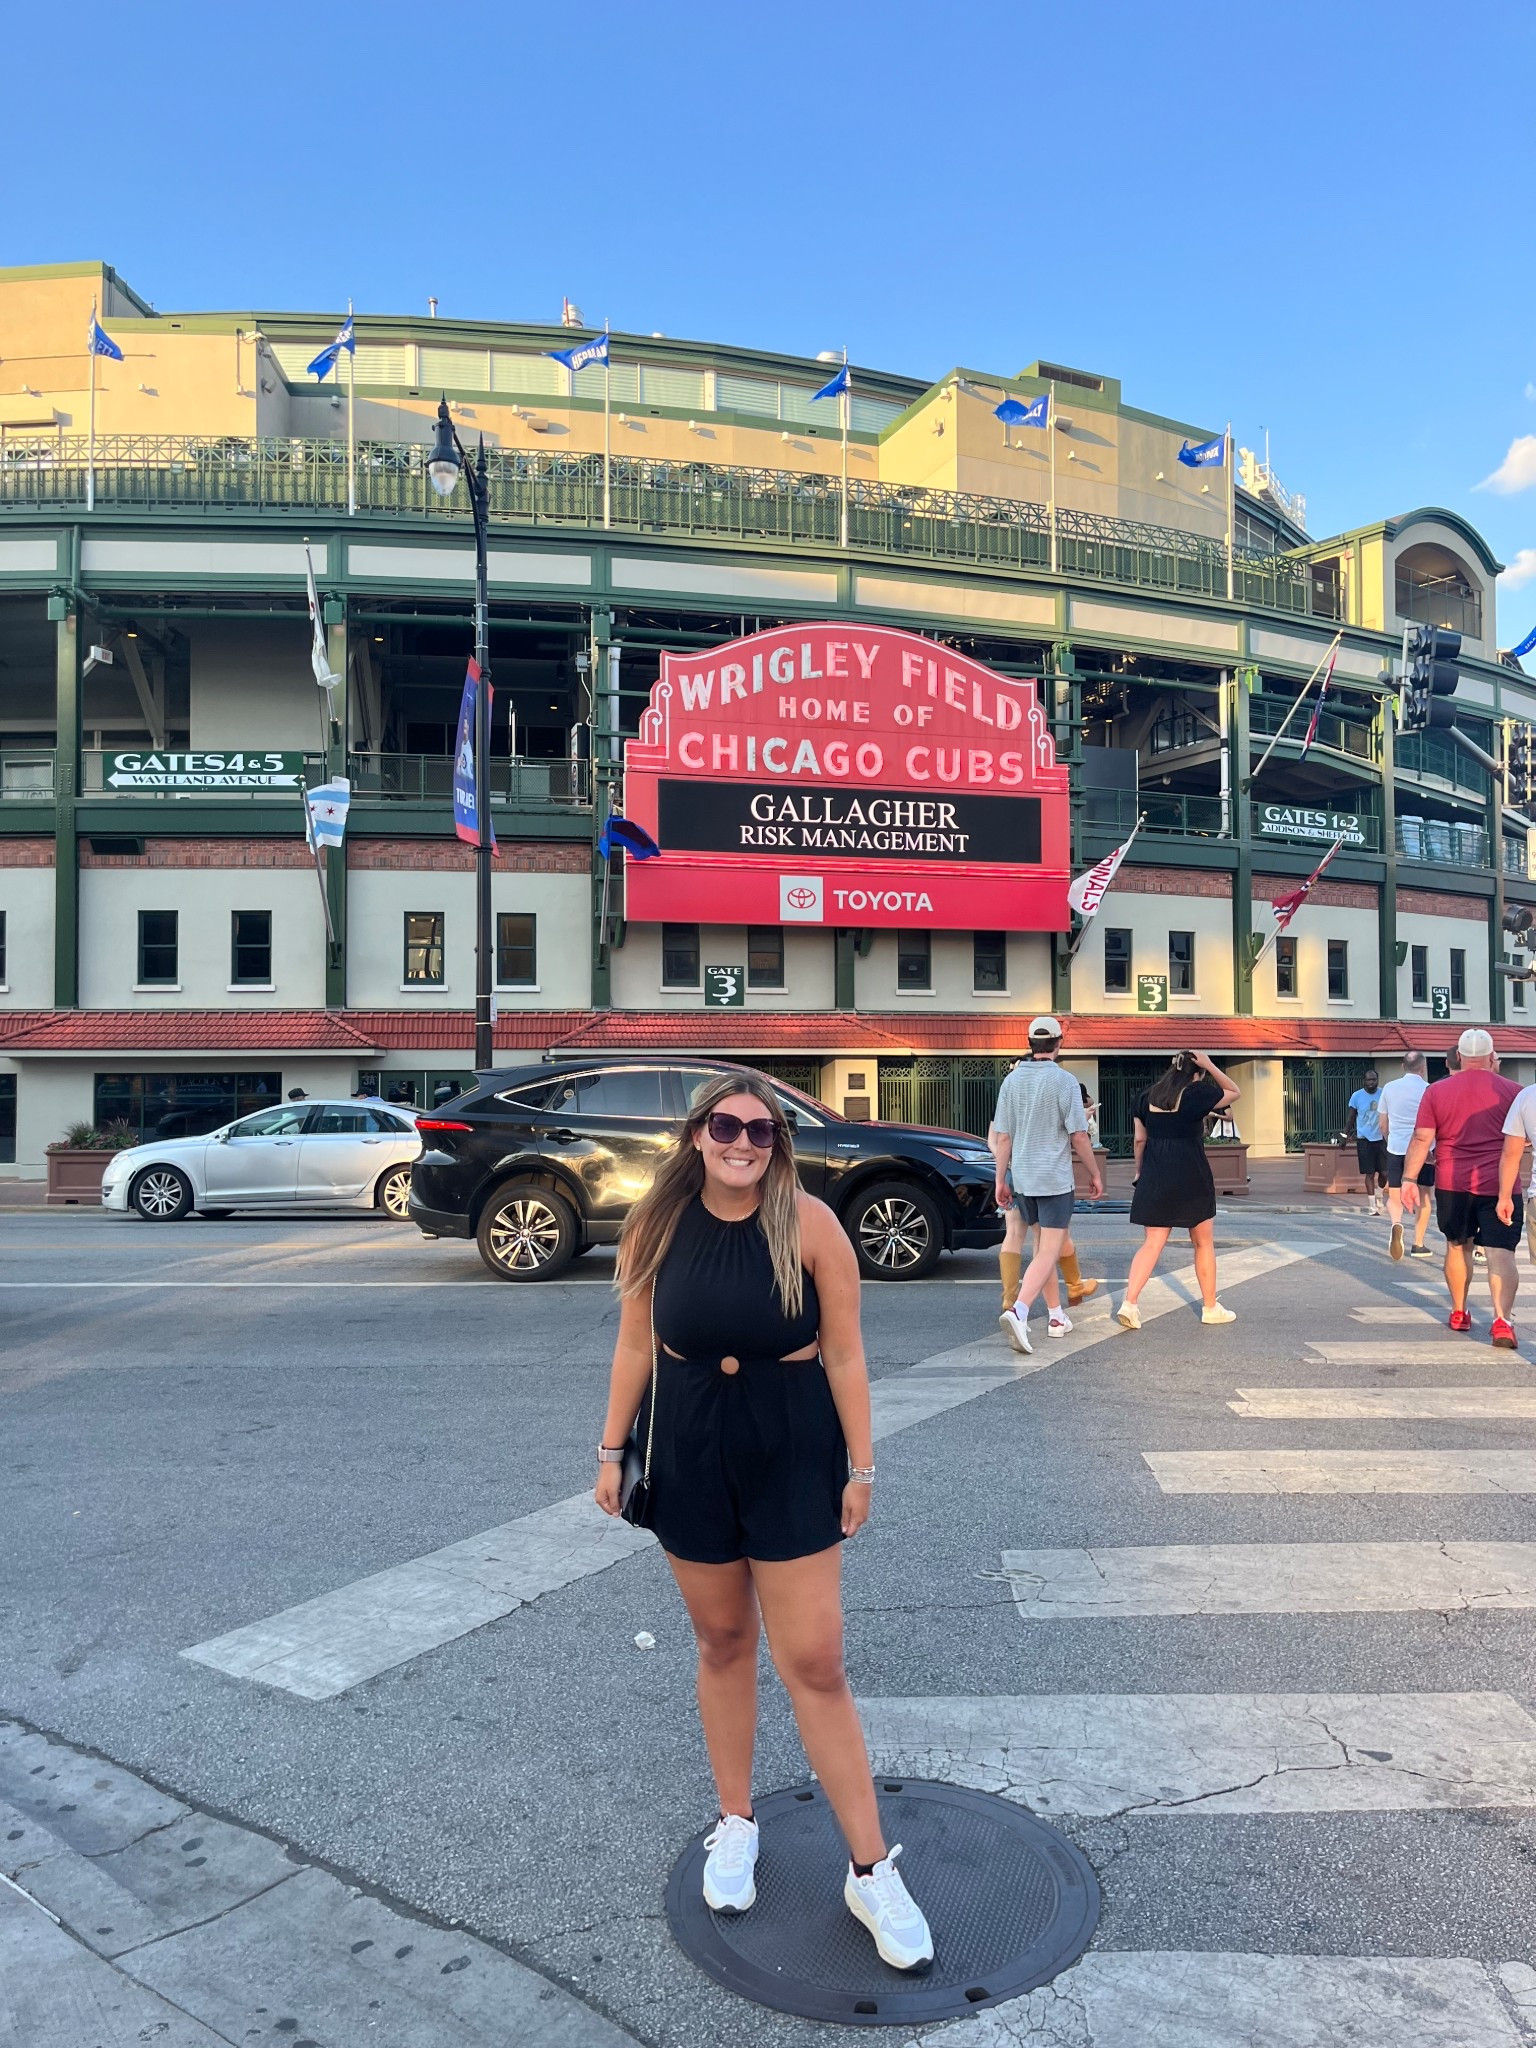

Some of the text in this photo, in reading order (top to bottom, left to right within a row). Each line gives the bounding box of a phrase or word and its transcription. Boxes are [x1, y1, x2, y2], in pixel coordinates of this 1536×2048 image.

[678, 641, 1022, 731] WRIGLEY FIELD
[779, 696, 934, 727] HOME OF
[678, 731, 1025, 785] CHICAGO CUBS
[132, 775, 276, 785] WAVELAND AVENUE
[750, 793, 960, 829] GALLAGHER
[1264, 806, 1327, 827] GATES
[740, 825, 970, 853] RISK MANAGEMENT
[1265, 823, 1306, 836] ADDISON
[832, 889, 934, 911] TOYOTA
[707, 967, 742, 975] GATE
[1139, 976, 1166, 984] GATE
[712, 975, 737, 997] 3
[1143, 983, 1162, 1004] 3
[1432, 987, 1449, 995] GATE
[1435, 994, 1448, 1012] 3
